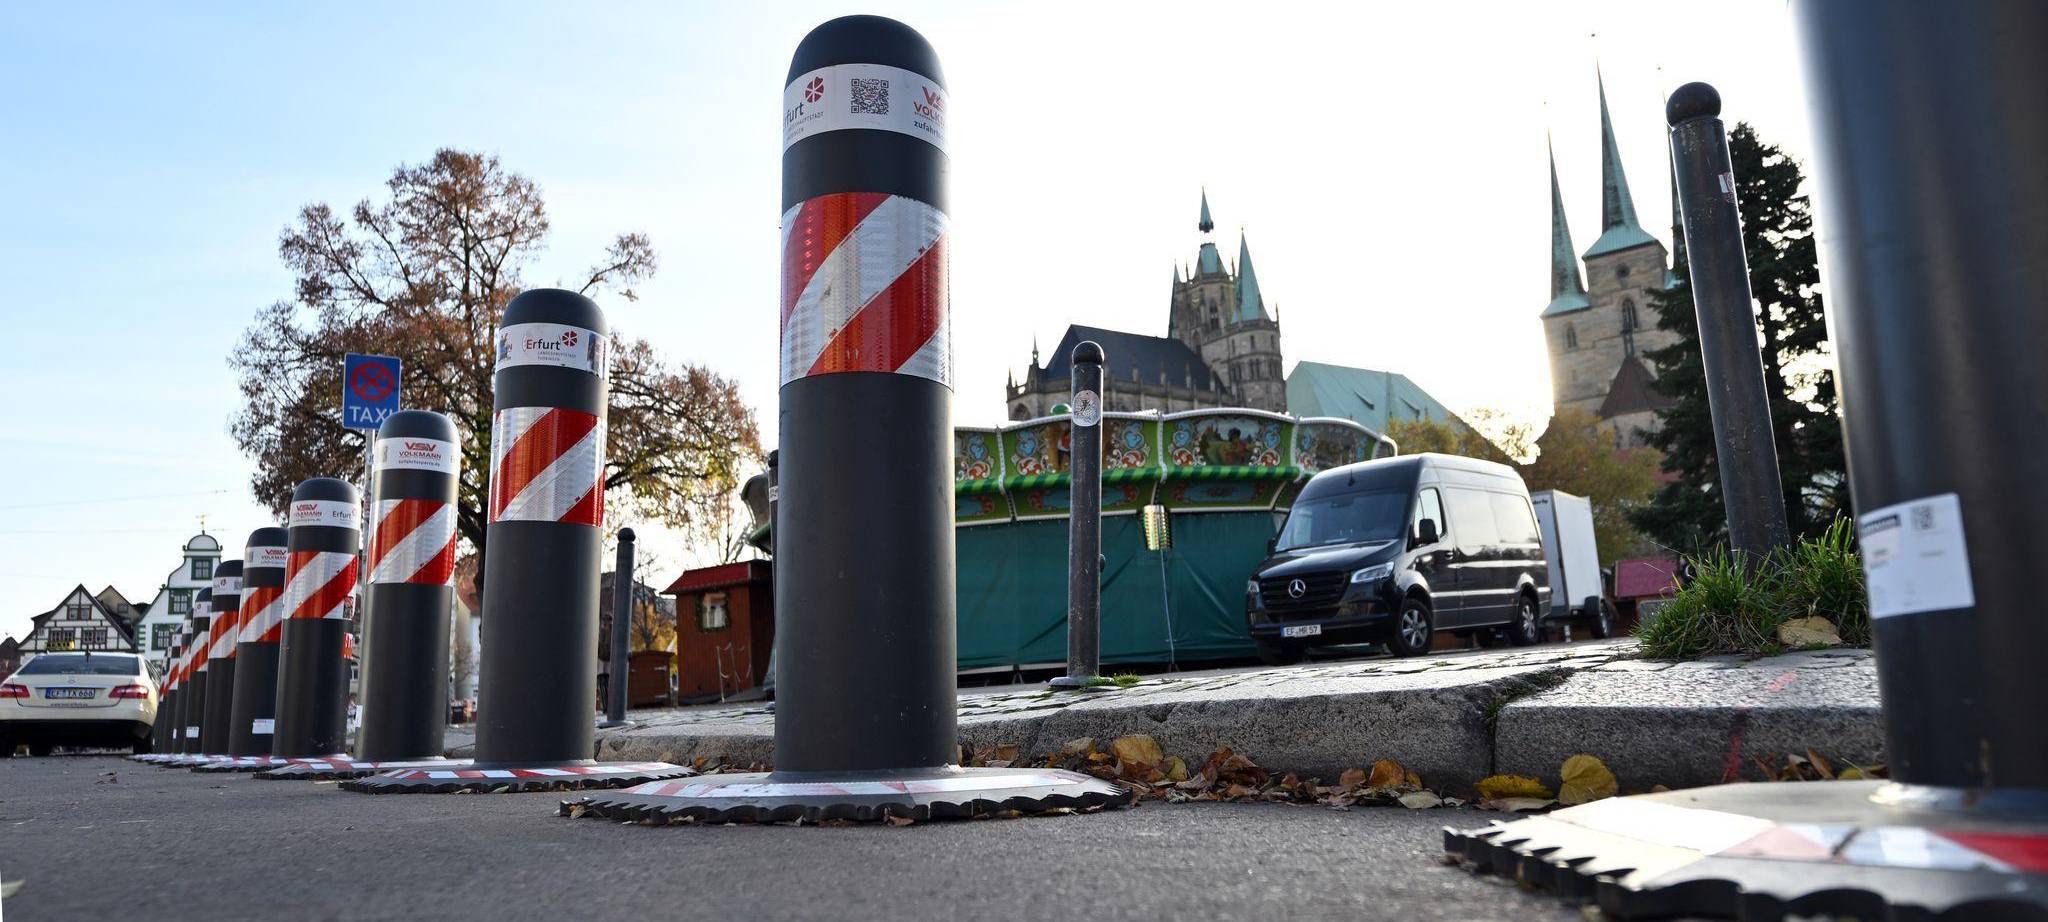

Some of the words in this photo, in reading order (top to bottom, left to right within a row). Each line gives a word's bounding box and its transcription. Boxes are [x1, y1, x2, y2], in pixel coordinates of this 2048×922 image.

[526, 338, 560, 350] Erfurt
[405, 441, 436, 451] VSV
[399, 451, 441, 459] VOLKMANN
[332, 510, 352, 519] Erfurt
